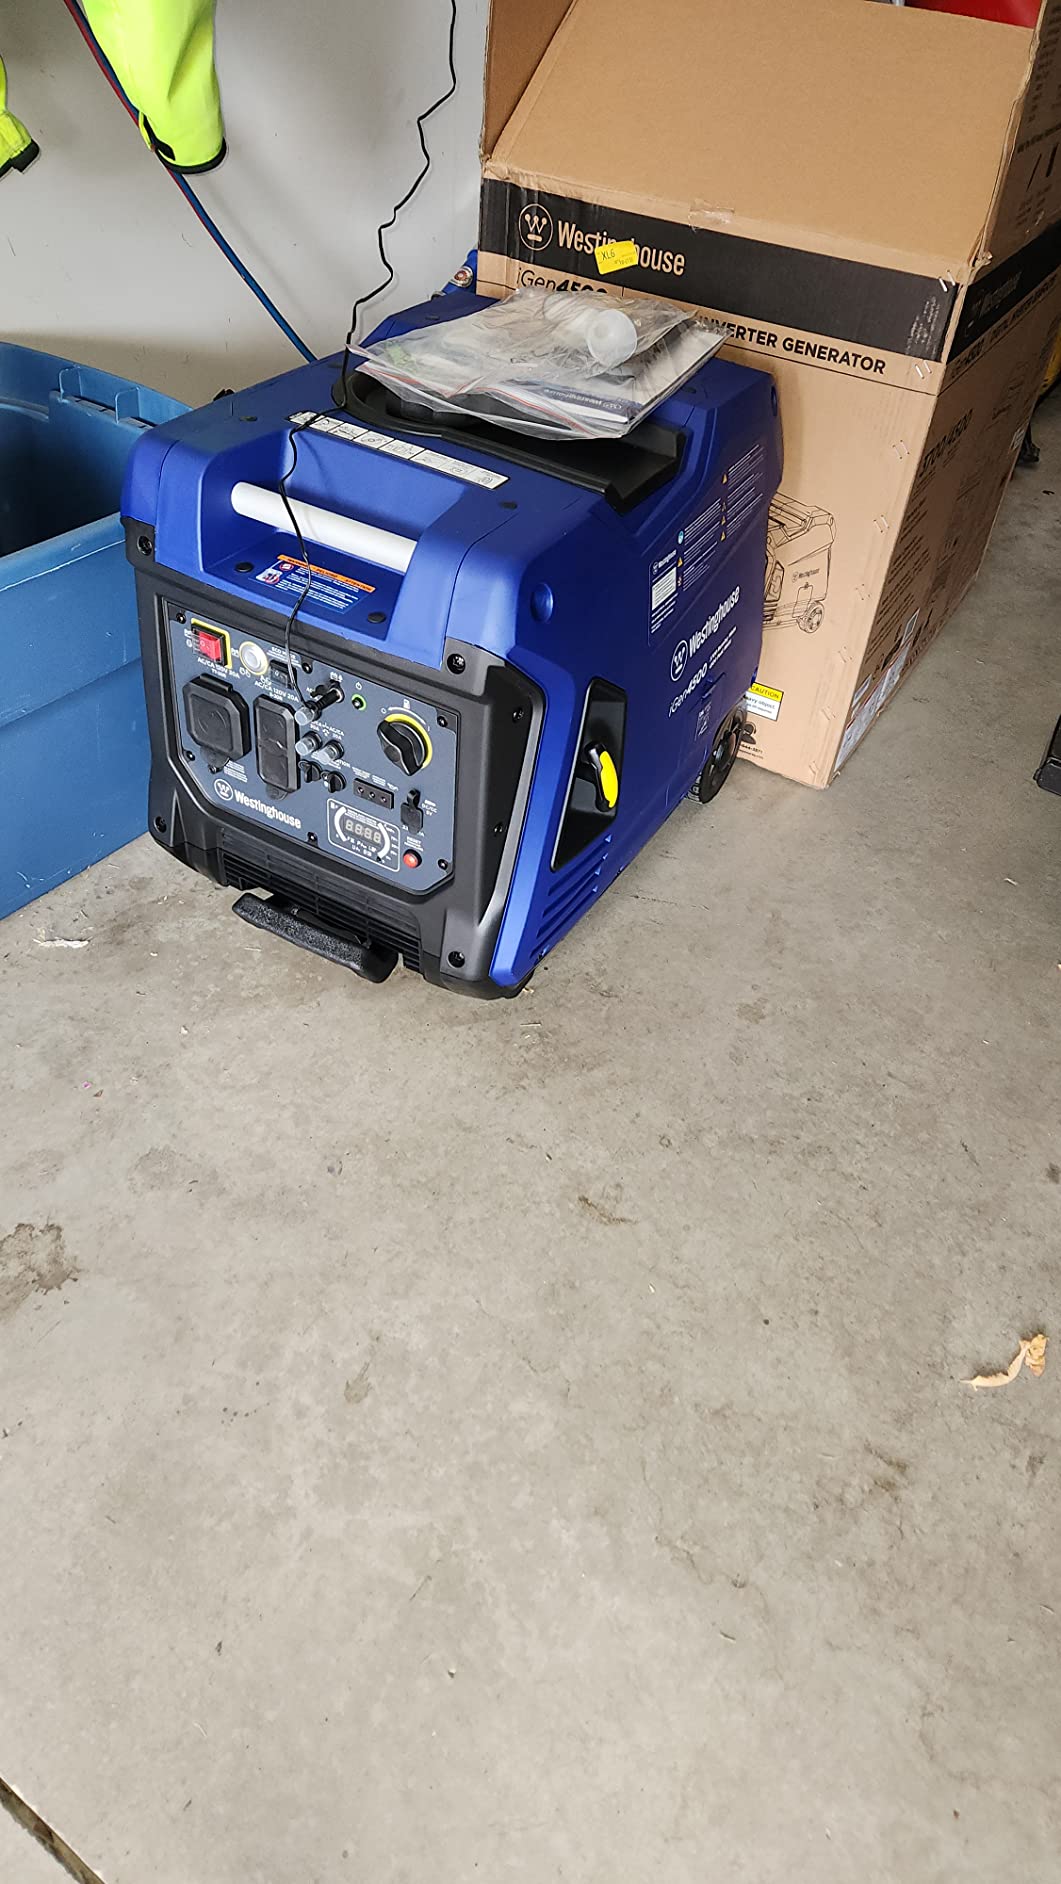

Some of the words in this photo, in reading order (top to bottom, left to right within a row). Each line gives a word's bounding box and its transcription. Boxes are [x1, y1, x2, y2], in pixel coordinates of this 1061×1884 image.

[557, 220, 685, 276] Westihouse
[516, 267, 607, 294] iGen45
[700, 315, 778, 349] ERTER
[782, 337, 886, 375] GENERATOR
[689, 585, 740, 658] Westinghouse
[668, 662, 708, 718] iGen4500
[750, 686, 779, 699] CAUTION
[233, 788, 302, 829] Westinghouse
